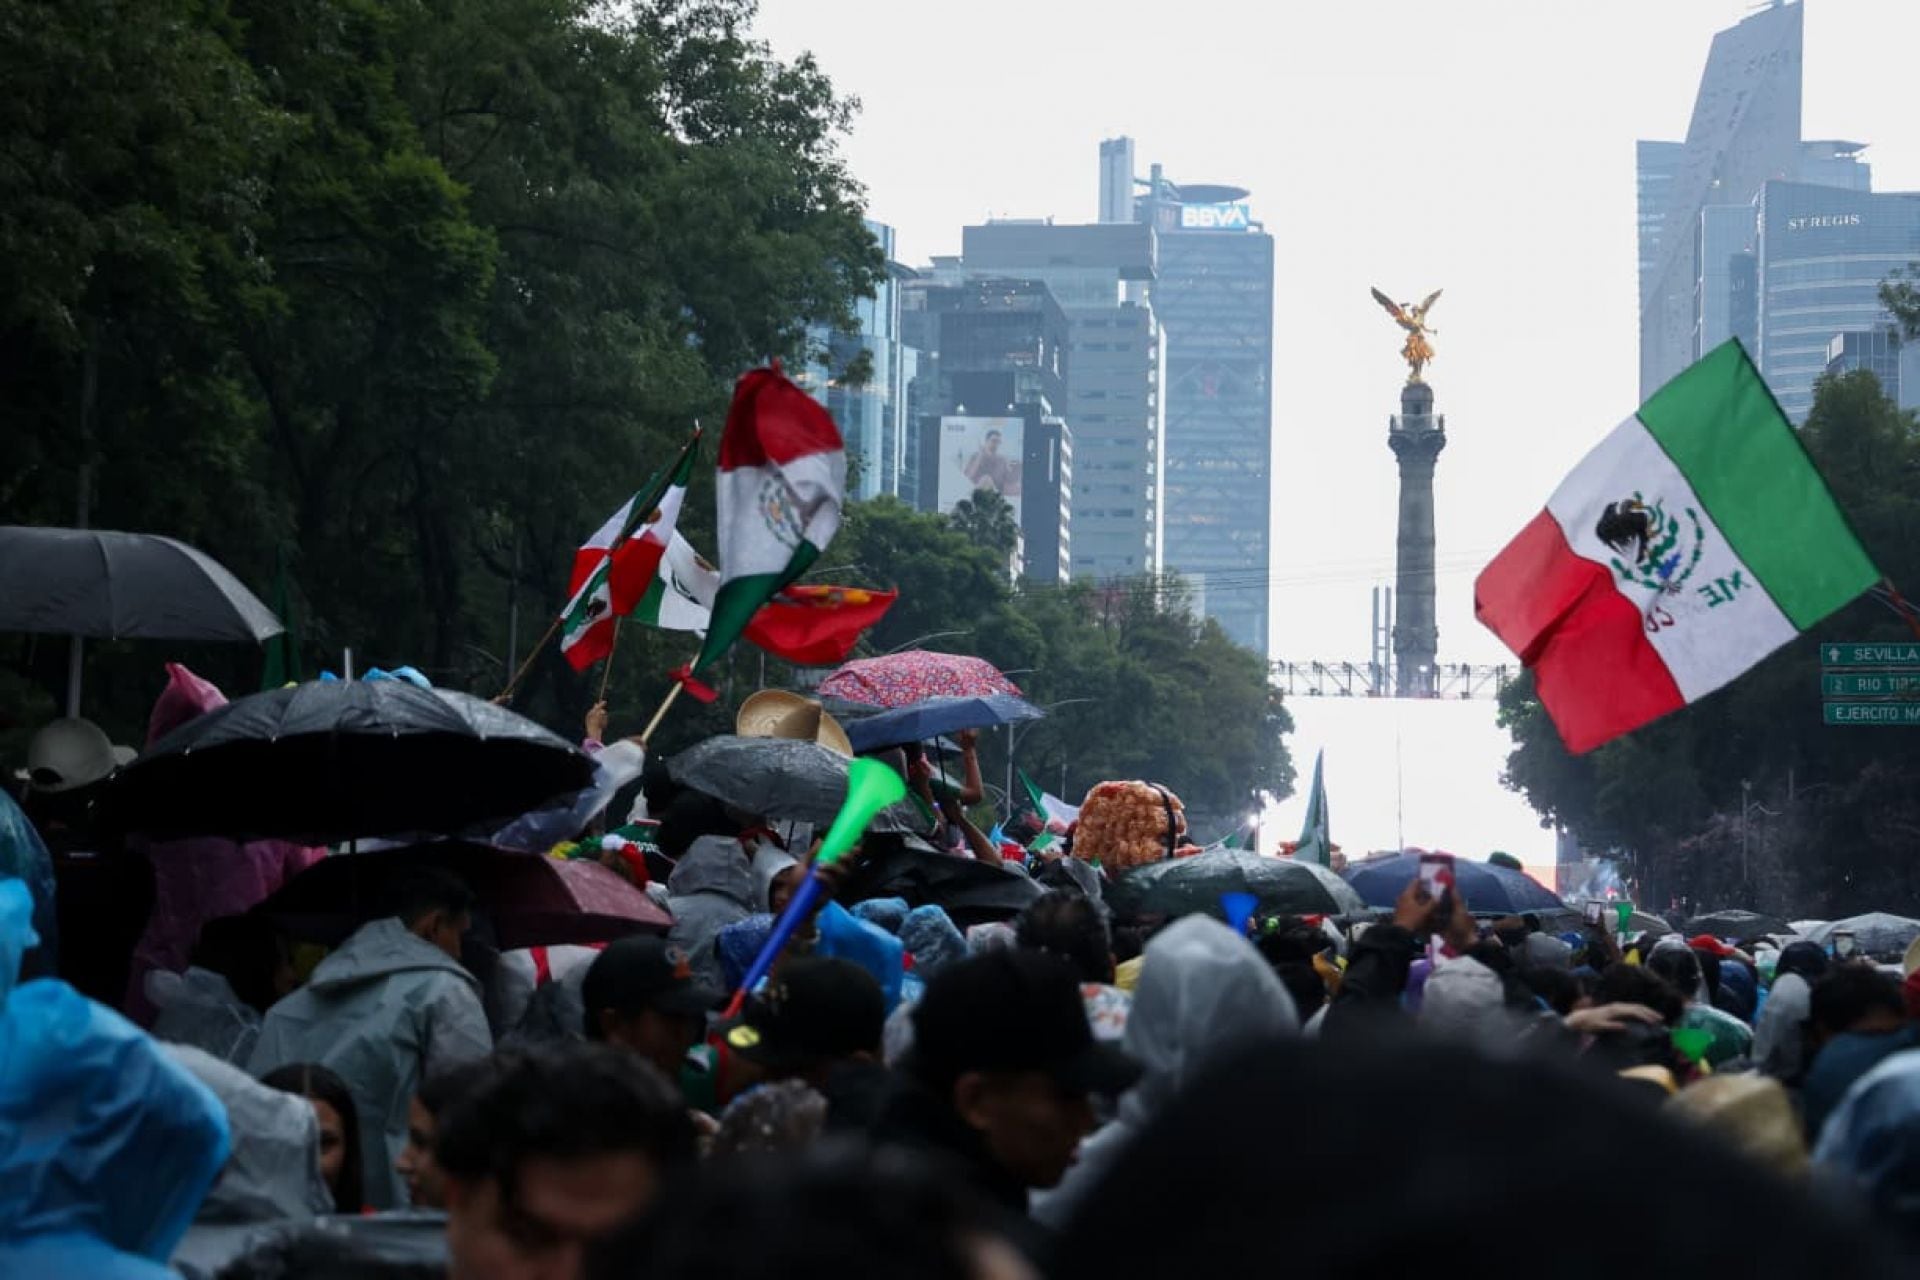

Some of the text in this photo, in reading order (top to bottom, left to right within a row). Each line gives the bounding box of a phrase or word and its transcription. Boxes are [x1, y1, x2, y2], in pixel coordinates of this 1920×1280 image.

[1182, 206, 1247, 228] BBVA
[1855, 647, 1918, 661] SEVILLA
[1836, 706, 1898, 720] EJERCITO
